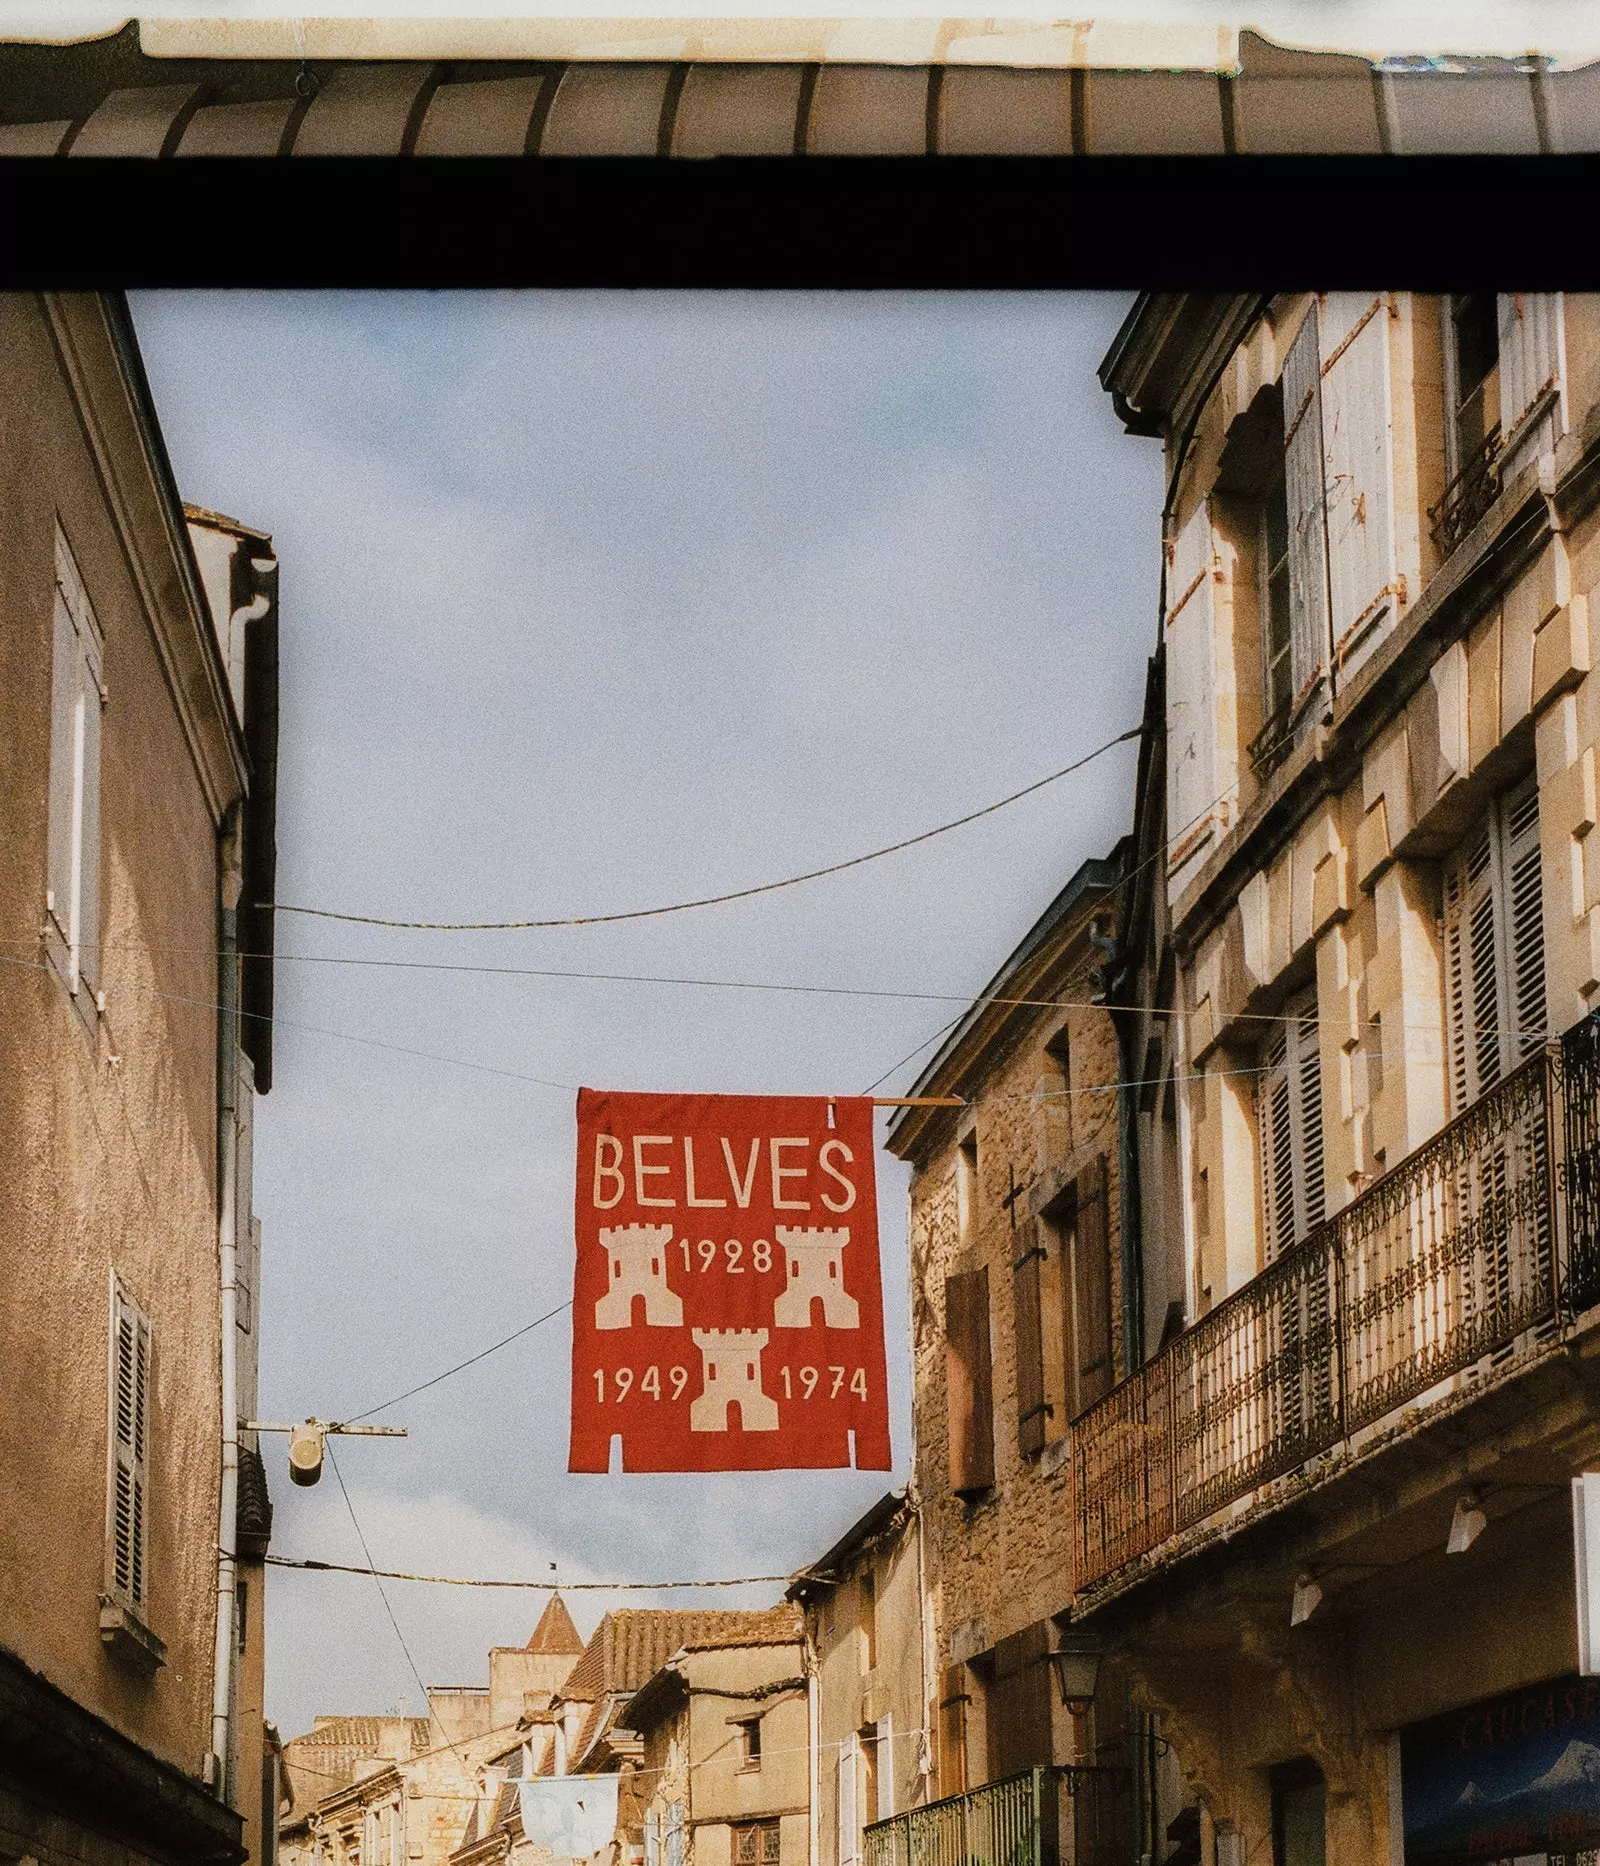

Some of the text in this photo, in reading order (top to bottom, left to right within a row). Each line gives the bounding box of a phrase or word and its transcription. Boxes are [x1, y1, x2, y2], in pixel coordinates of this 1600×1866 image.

[679, 1238, 772, 1274] 1928
[593, 1366, 689, 1403] 1949
[780, 1366, 868, 1402] 1974
